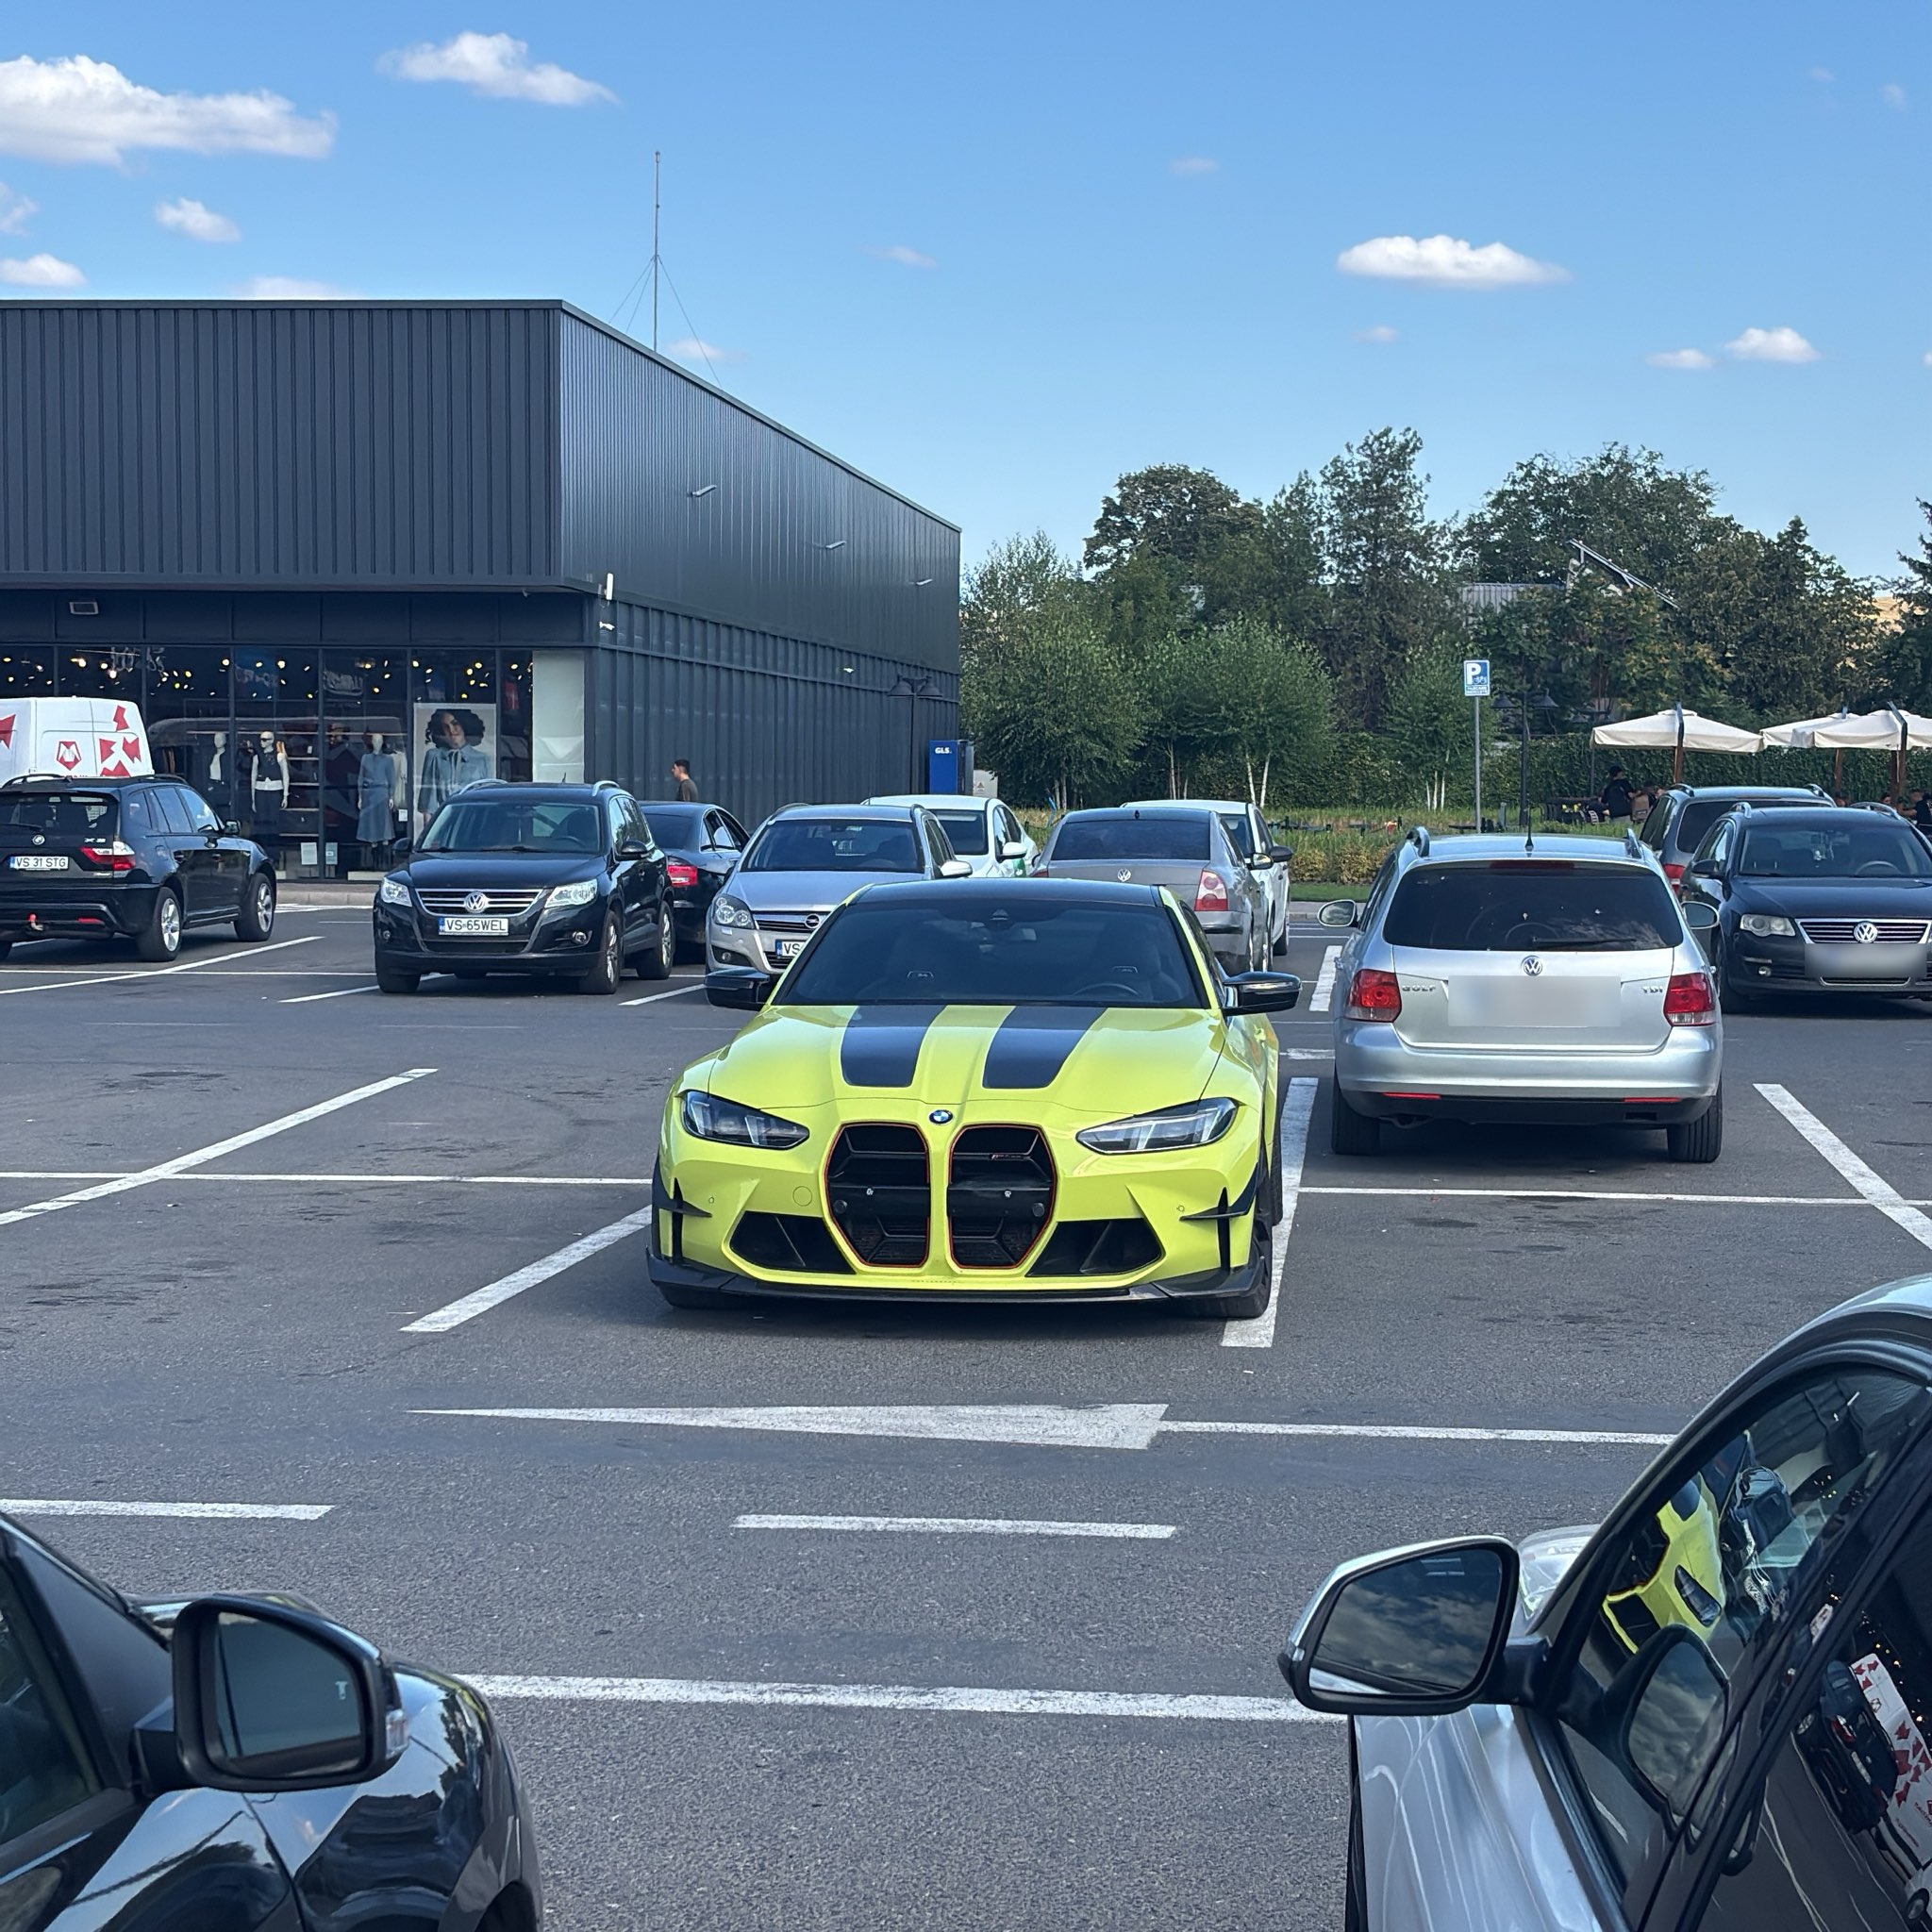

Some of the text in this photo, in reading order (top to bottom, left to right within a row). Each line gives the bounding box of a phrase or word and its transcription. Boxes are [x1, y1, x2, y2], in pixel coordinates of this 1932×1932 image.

[1467, 663, 1481, 685] P
[16, 858, 66, 867] VS 31 STG
